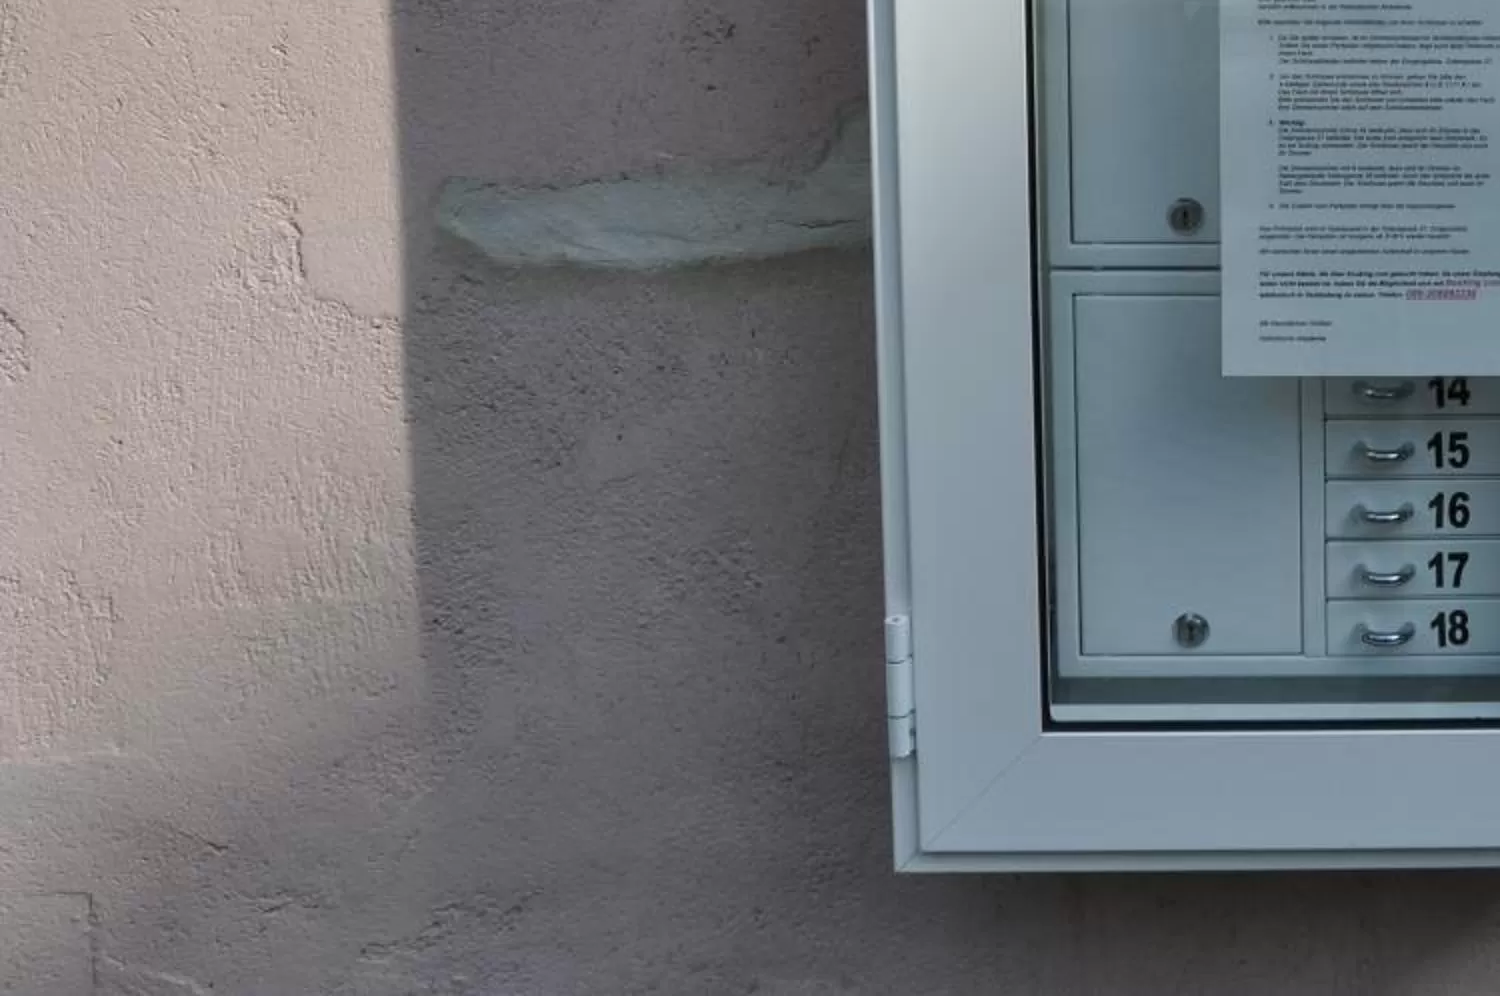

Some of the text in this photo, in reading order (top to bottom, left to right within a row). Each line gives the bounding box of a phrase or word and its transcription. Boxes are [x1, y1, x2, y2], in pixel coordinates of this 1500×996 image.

[1428, 377, 1471, 409] 14
[1427, 432, 1470, 469] 15
[1428, 491, 1470, 529] 16
[1428, 551, 1469, 588] 17
[1430, 609, 1469, 648] 18
